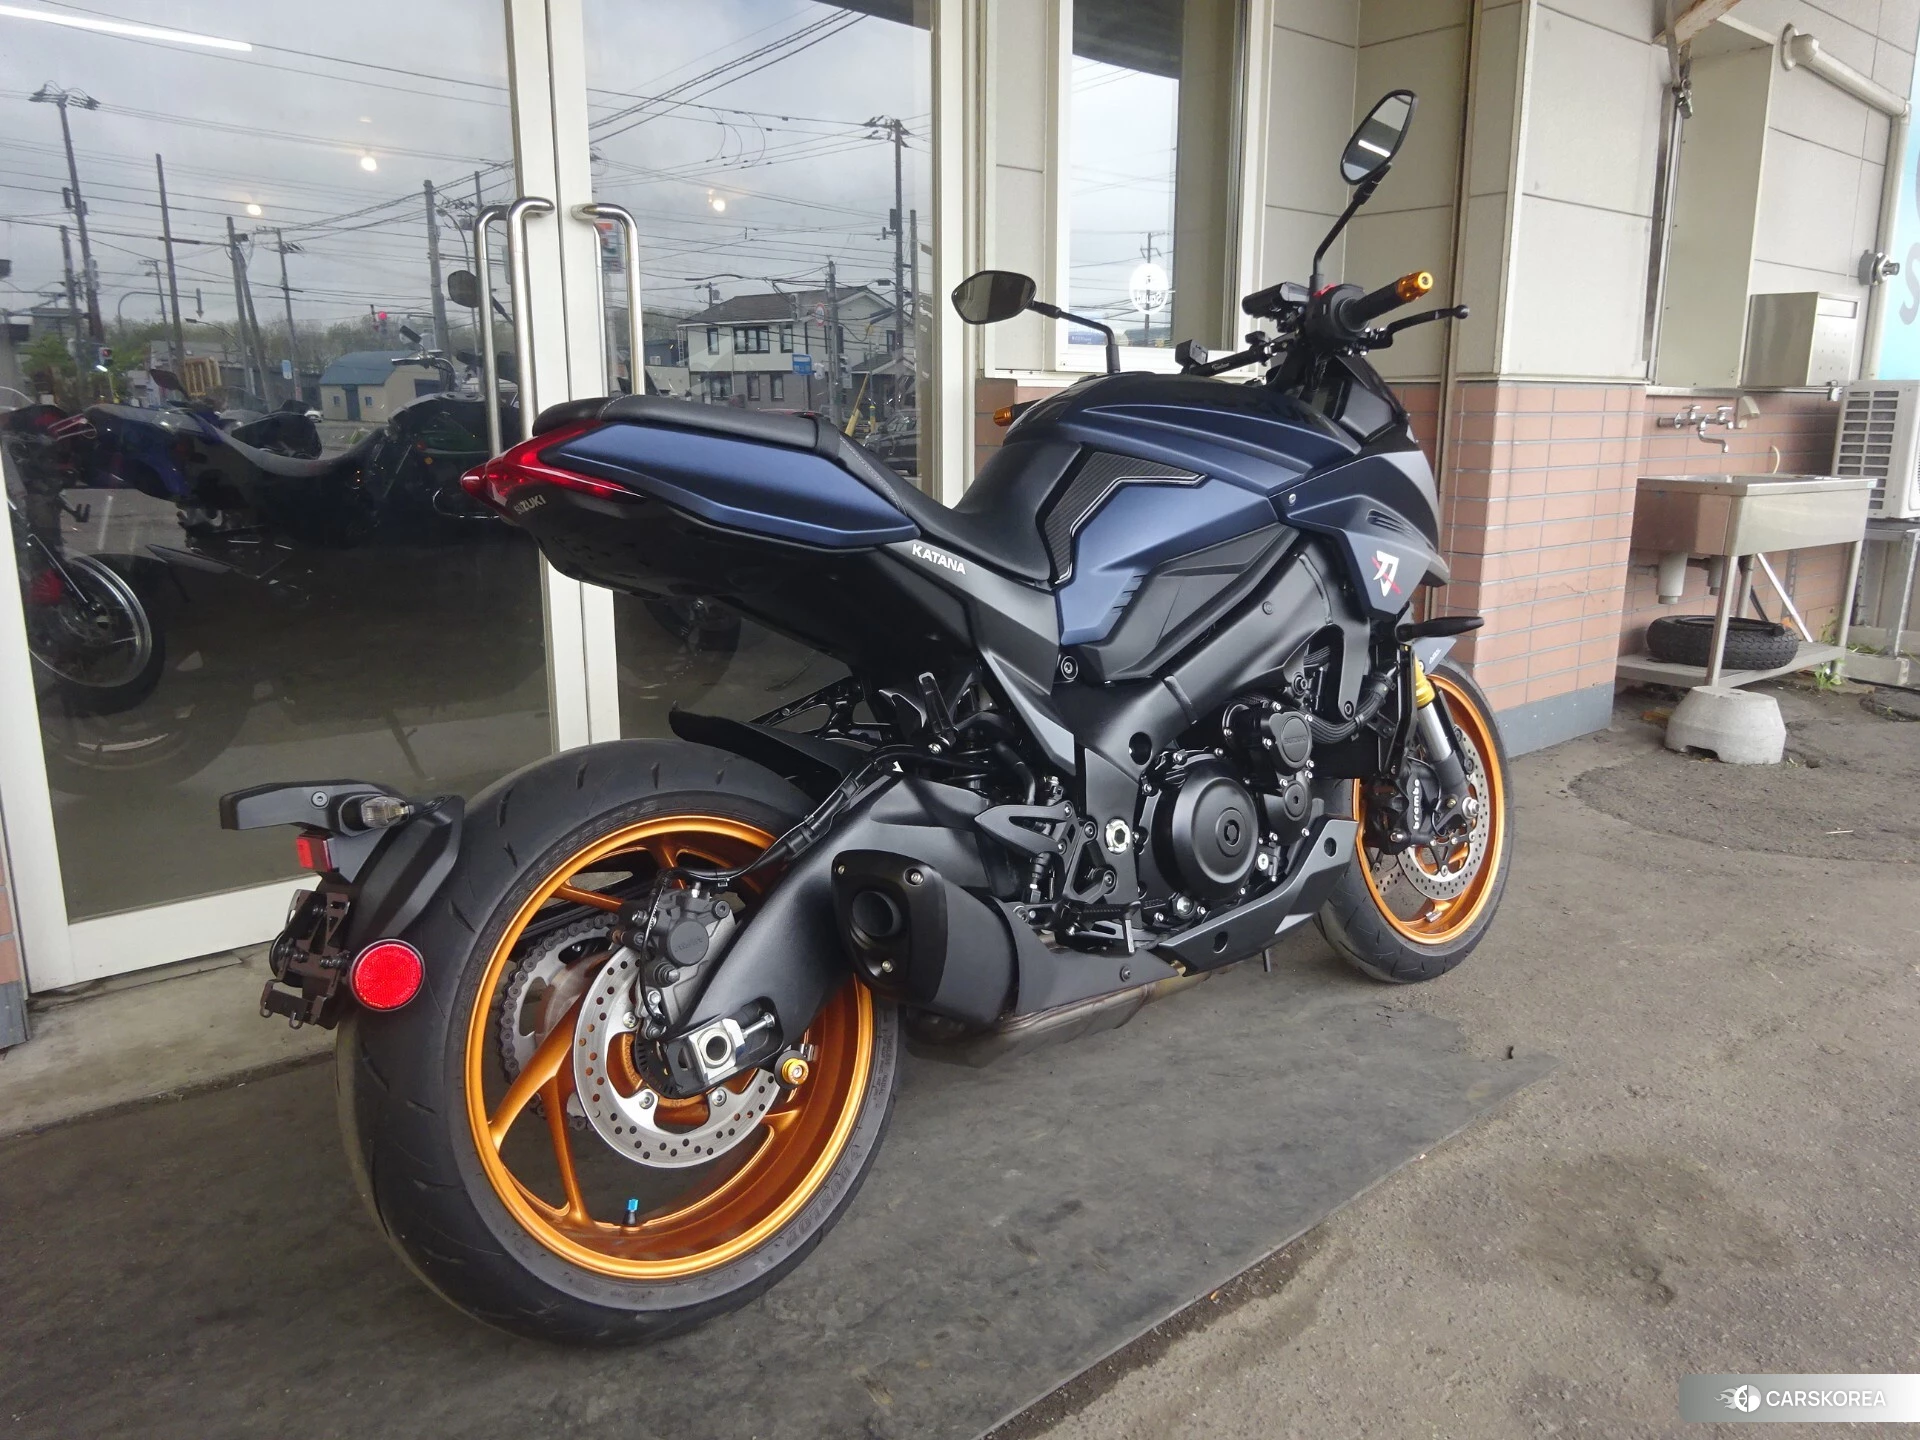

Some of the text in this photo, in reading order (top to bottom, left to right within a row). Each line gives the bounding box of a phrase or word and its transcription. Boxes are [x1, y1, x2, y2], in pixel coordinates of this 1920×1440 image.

[513, 494, 547, 515] SUZUKI
[912, 543, 966, 575] KATANA
[1412, 778, 1420, 830] brembo
